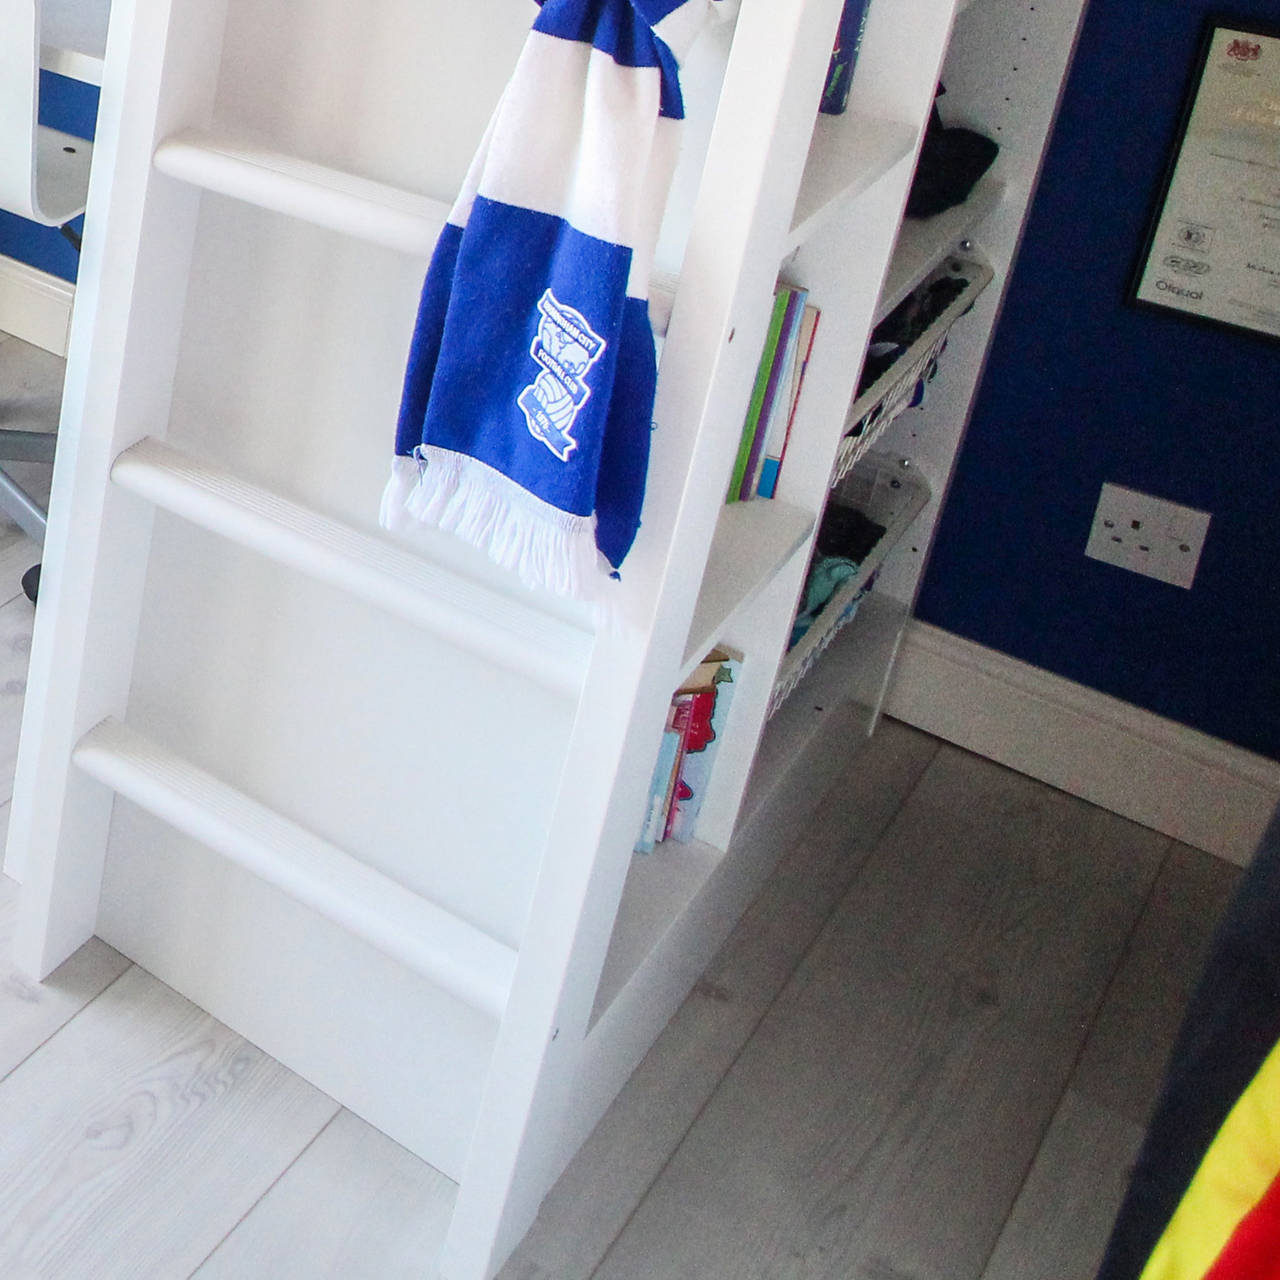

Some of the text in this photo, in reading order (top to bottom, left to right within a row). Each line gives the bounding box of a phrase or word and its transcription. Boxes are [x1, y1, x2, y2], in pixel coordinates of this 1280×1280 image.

[577, 333, 597, 351] CITY
[537, 348, 579, 395] FOOTBALL CLUB
